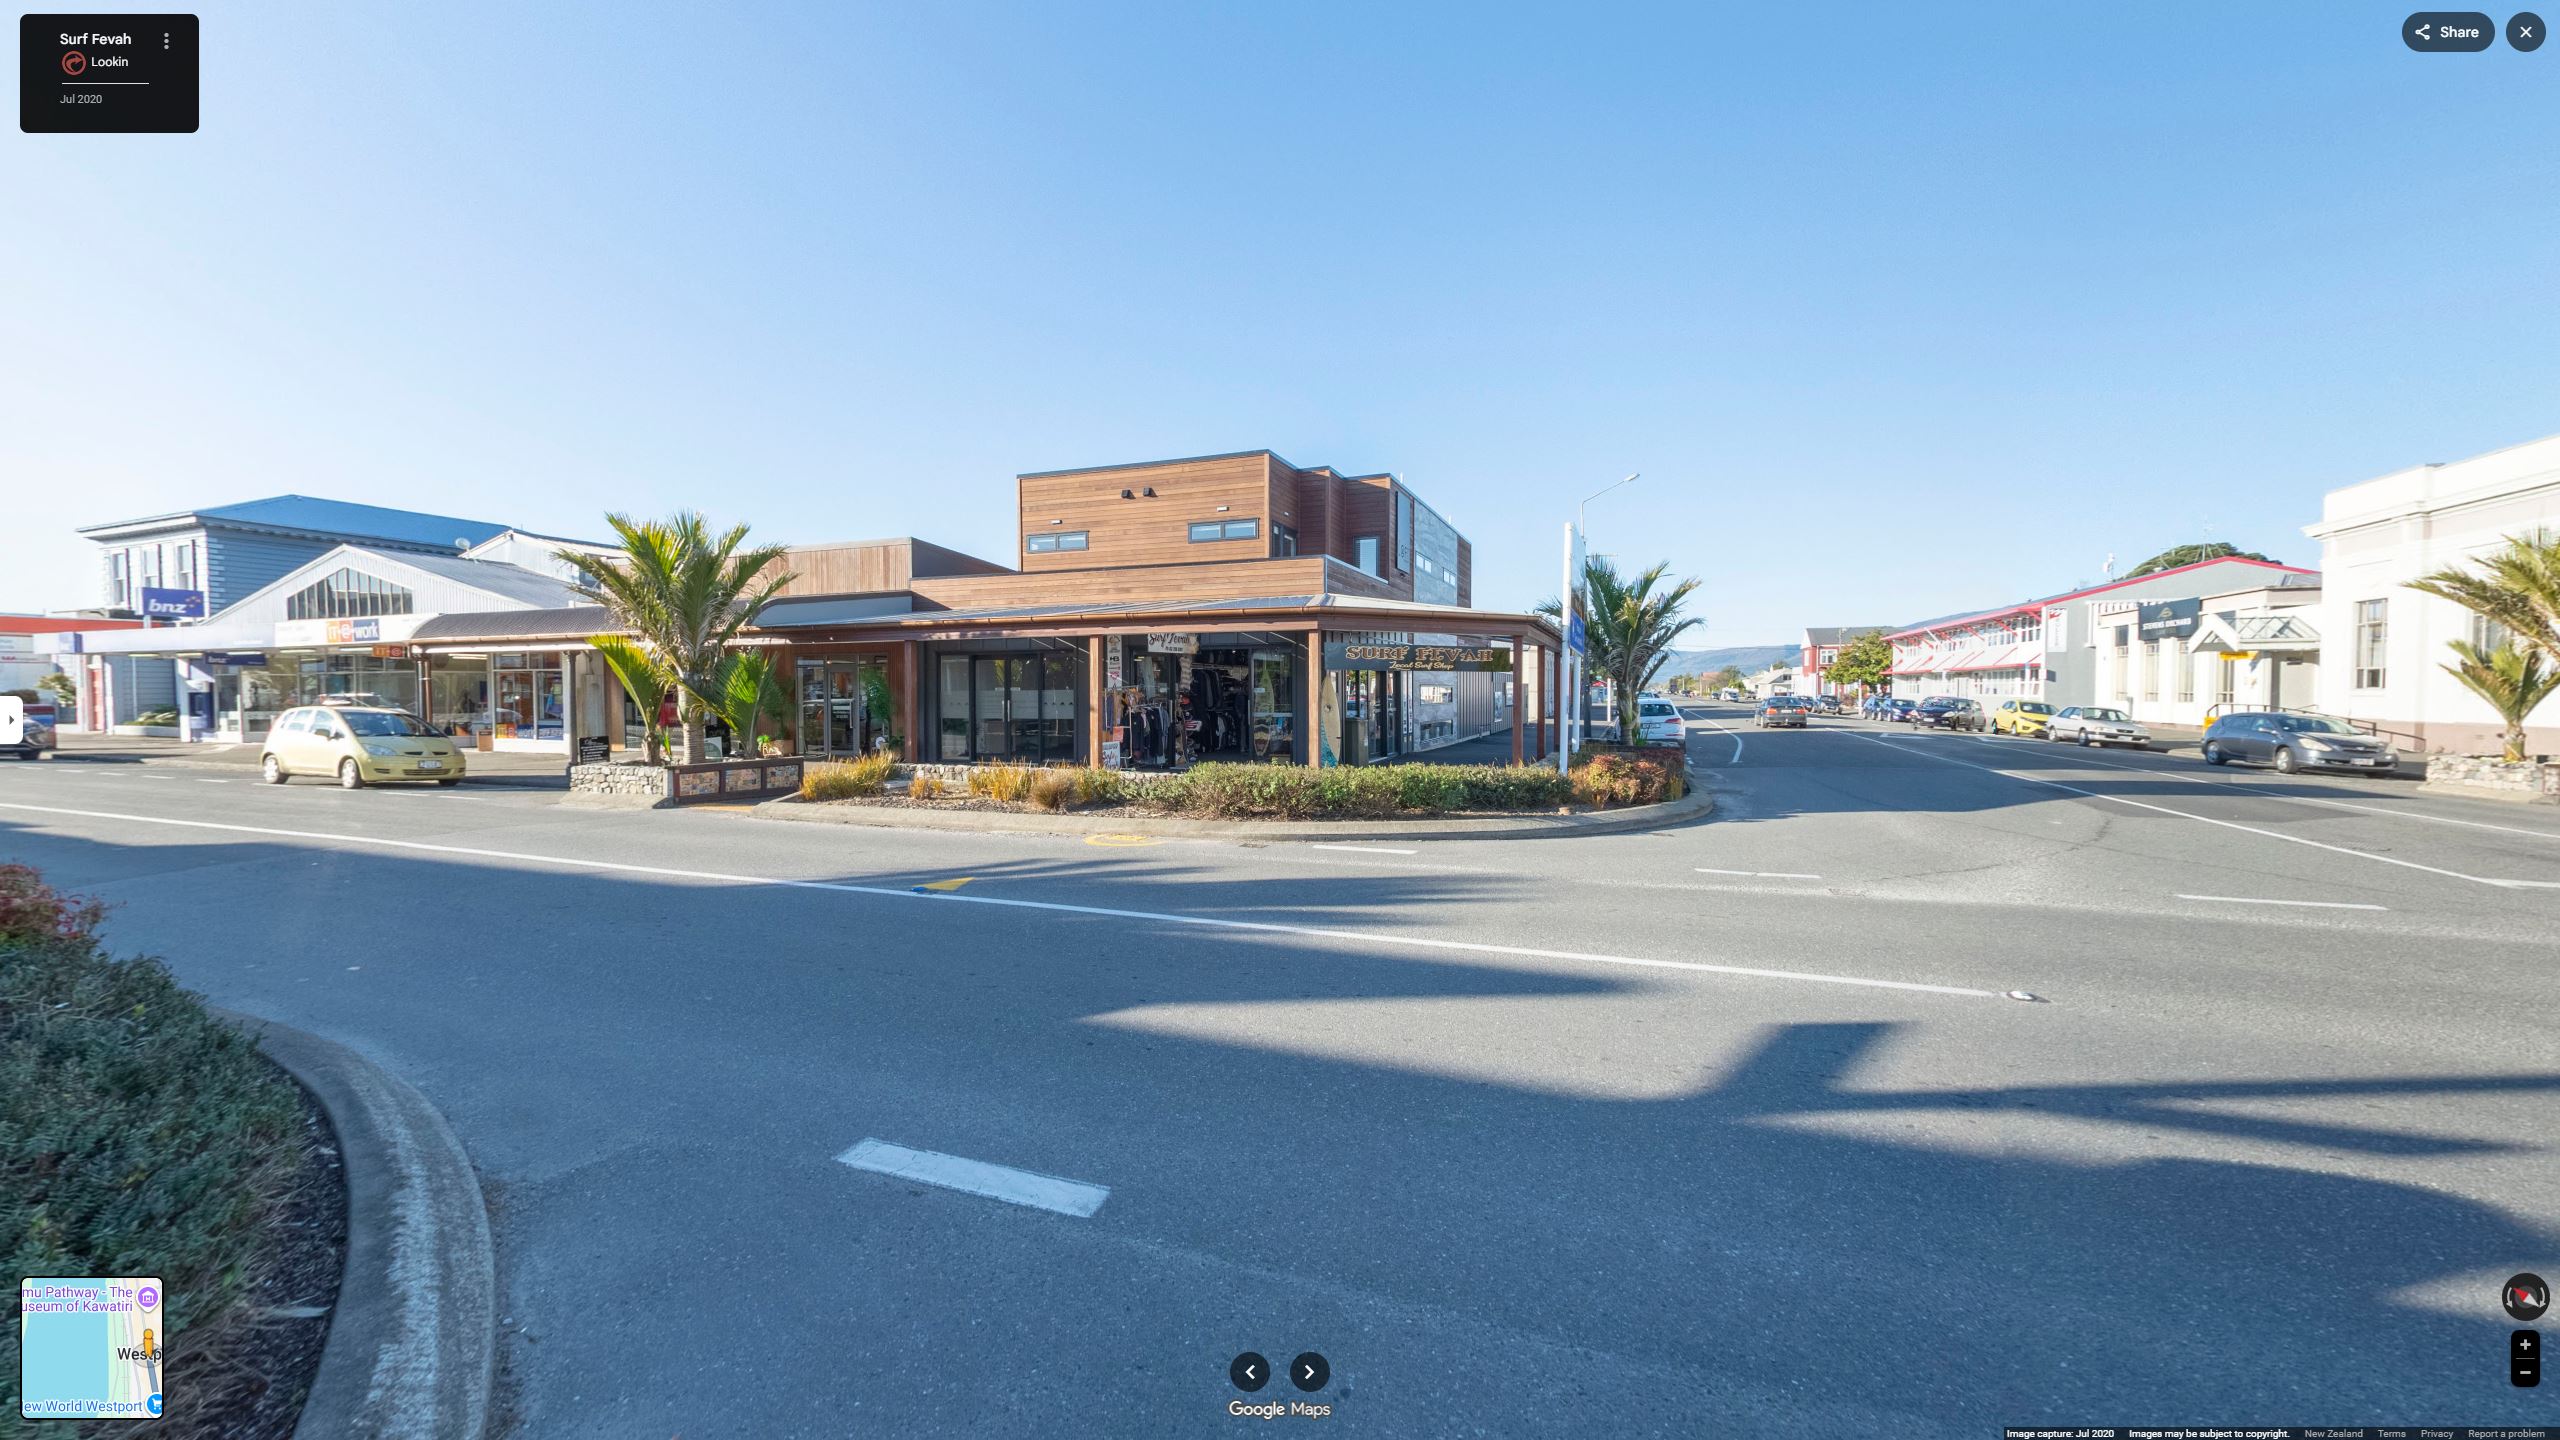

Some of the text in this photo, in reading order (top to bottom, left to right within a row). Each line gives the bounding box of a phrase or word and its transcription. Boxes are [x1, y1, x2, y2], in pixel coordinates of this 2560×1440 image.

[148, 598, 187, 613] bnz
[1346, 646, 1494, 661] SURF FEVAH
[1390, 661, 1454, 671] Local Surf Shop
